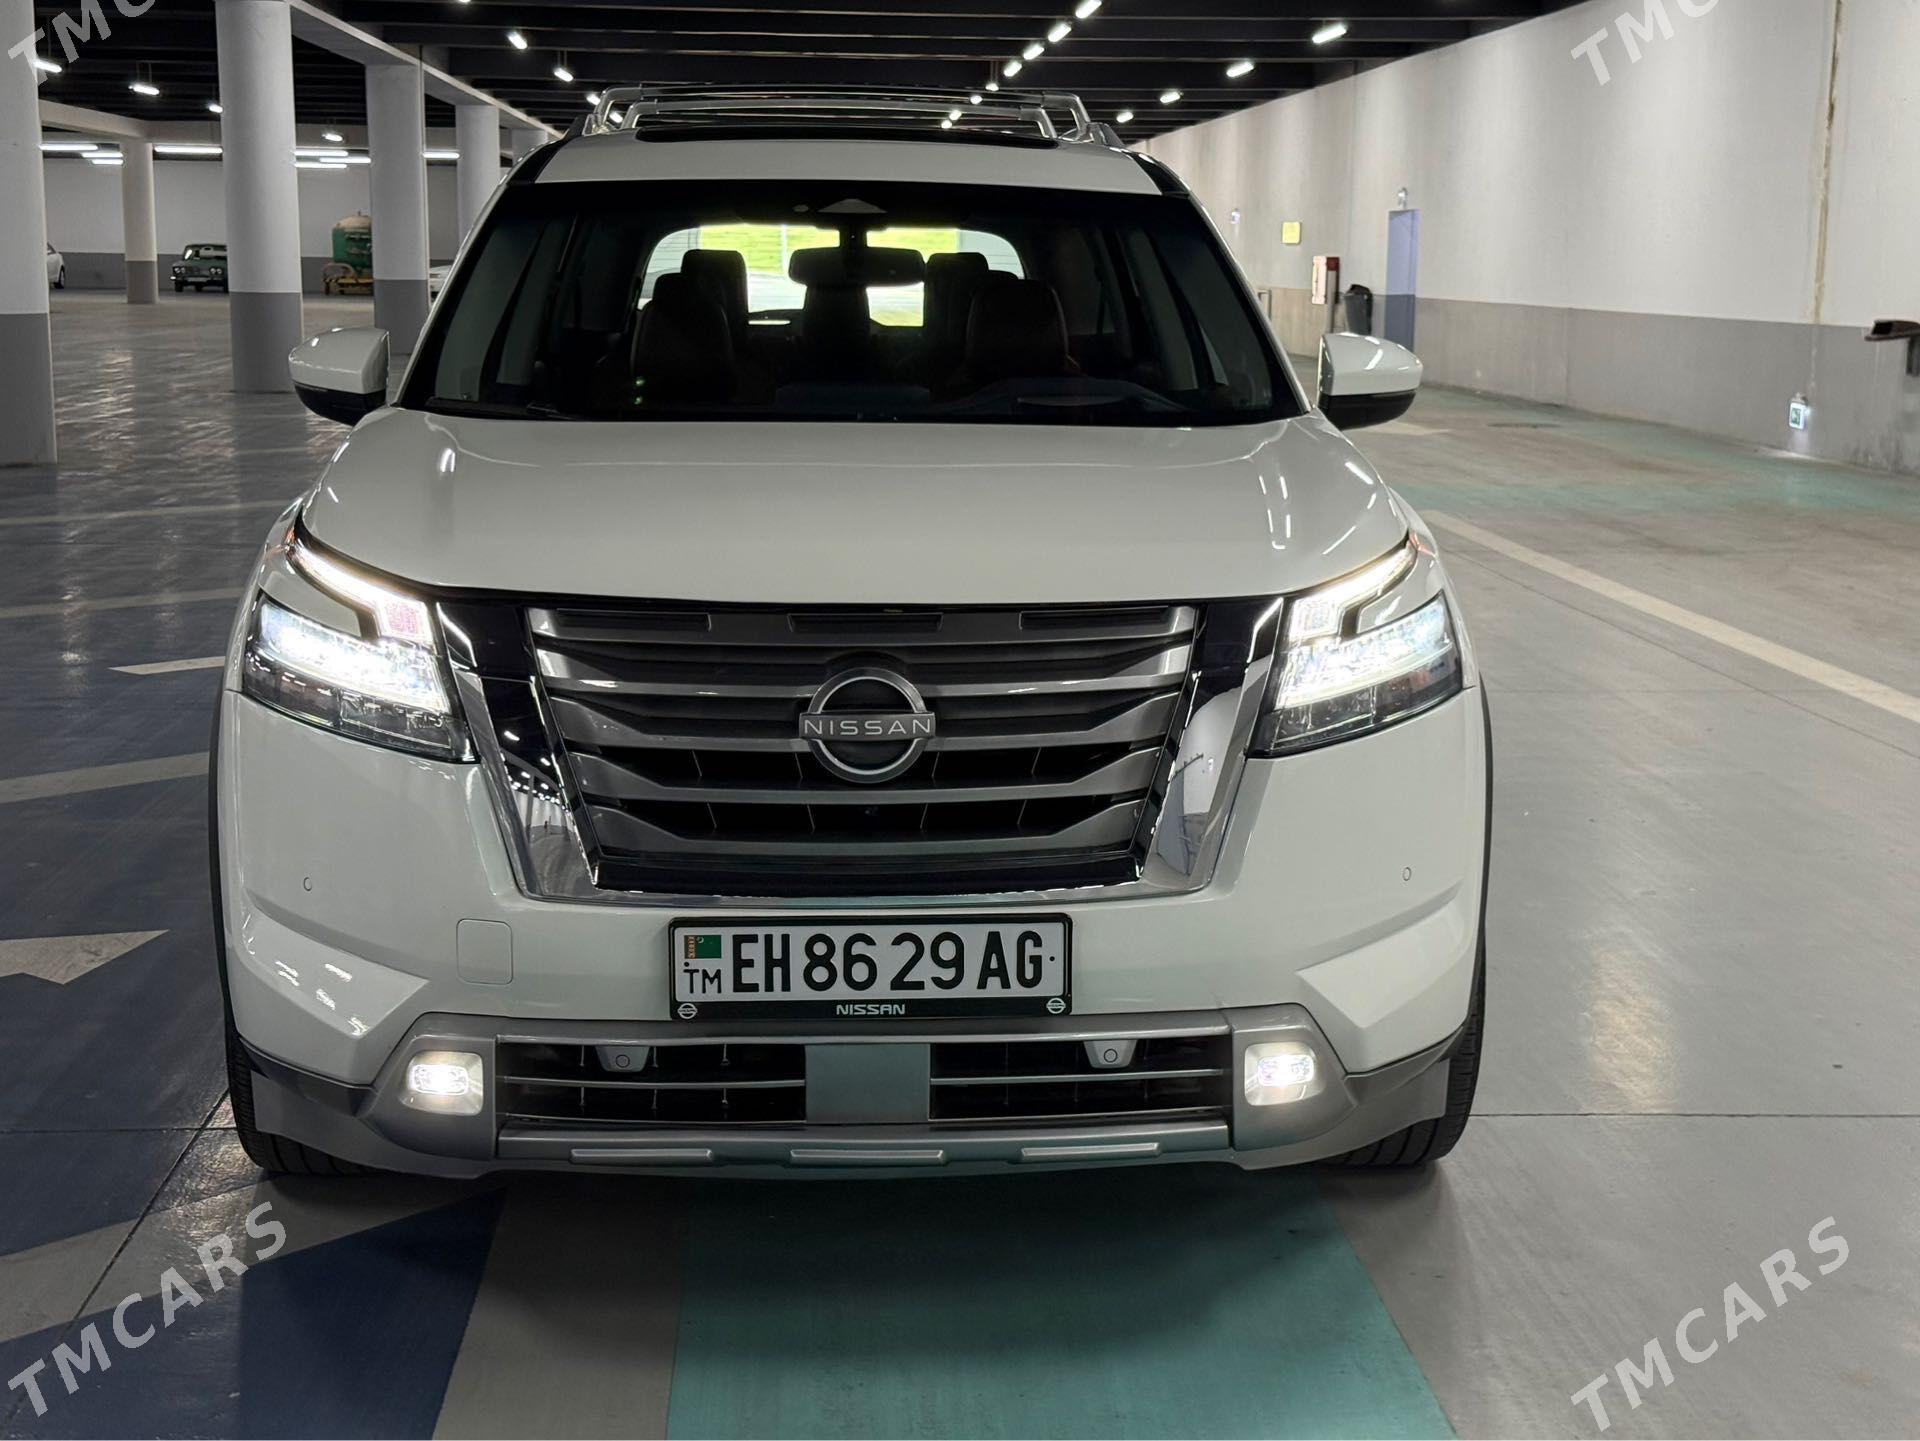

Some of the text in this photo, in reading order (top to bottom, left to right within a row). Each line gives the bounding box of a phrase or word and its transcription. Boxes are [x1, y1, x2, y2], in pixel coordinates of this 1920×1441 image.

[804, 718, 931, 736] NISSAN
[683, 968, 722, 994] TM
[836, 1003, 906, 1016] NISSAN
